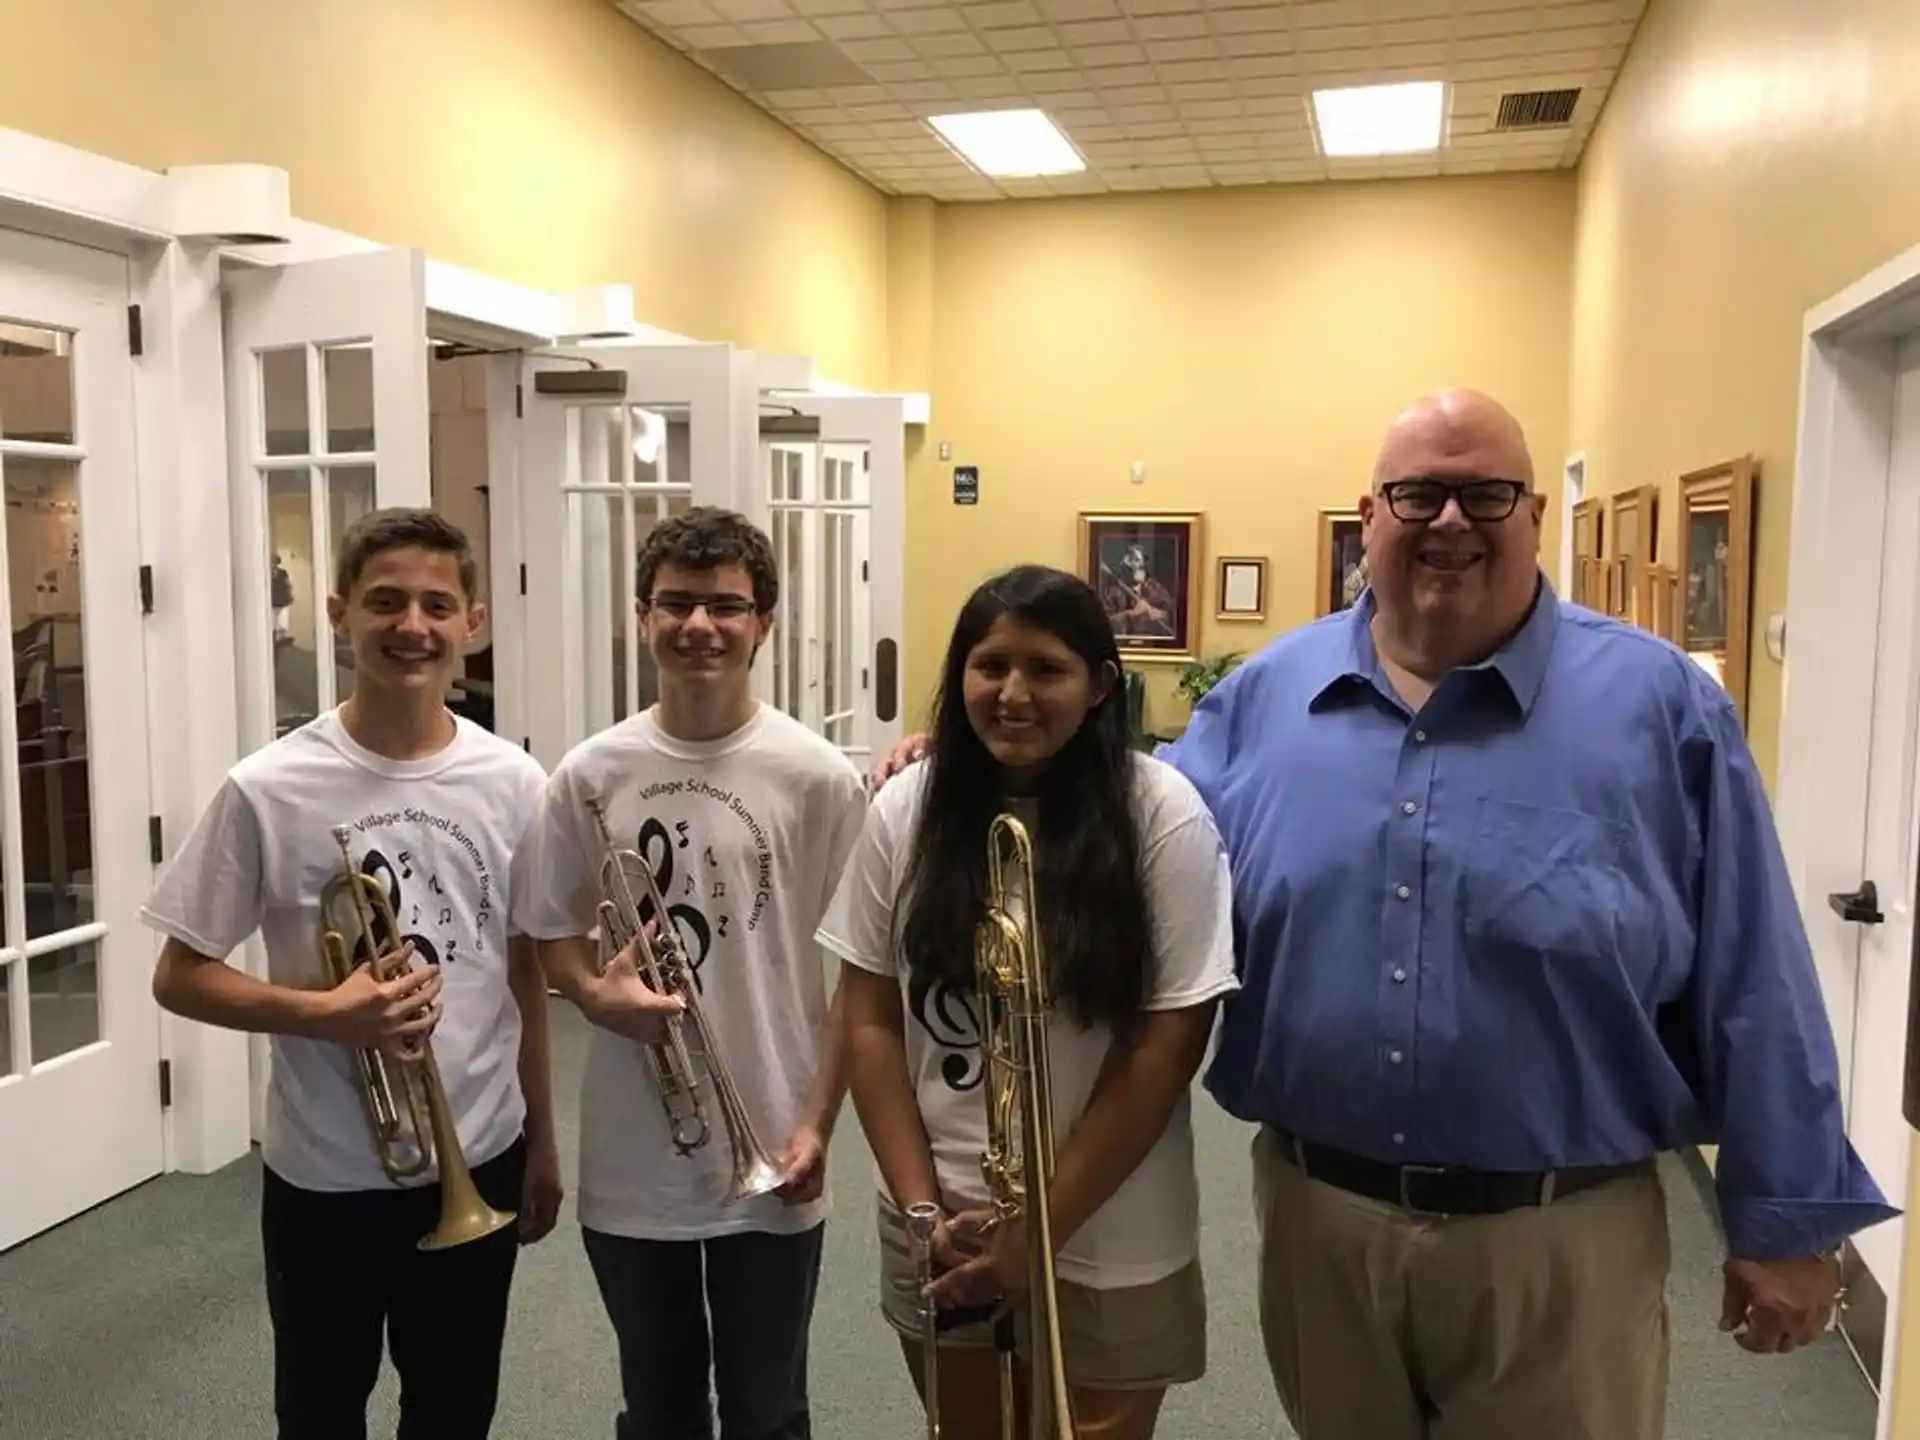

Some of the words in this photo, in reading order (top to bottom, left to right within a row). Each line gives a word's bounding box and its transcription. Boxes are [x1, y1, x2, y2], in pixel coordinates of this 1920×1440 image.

[354, 810, 401, 833] Village
[403, 807, 451, 832] School
[449, 823, 486, 873] Summer
[480, 874, 493, 910] Band
[640, 781, 684, 801] Village
[685, 778, 733, 804] School
[729, 798, 767, 849] Summer
[758, 852, 772, 889] Band
